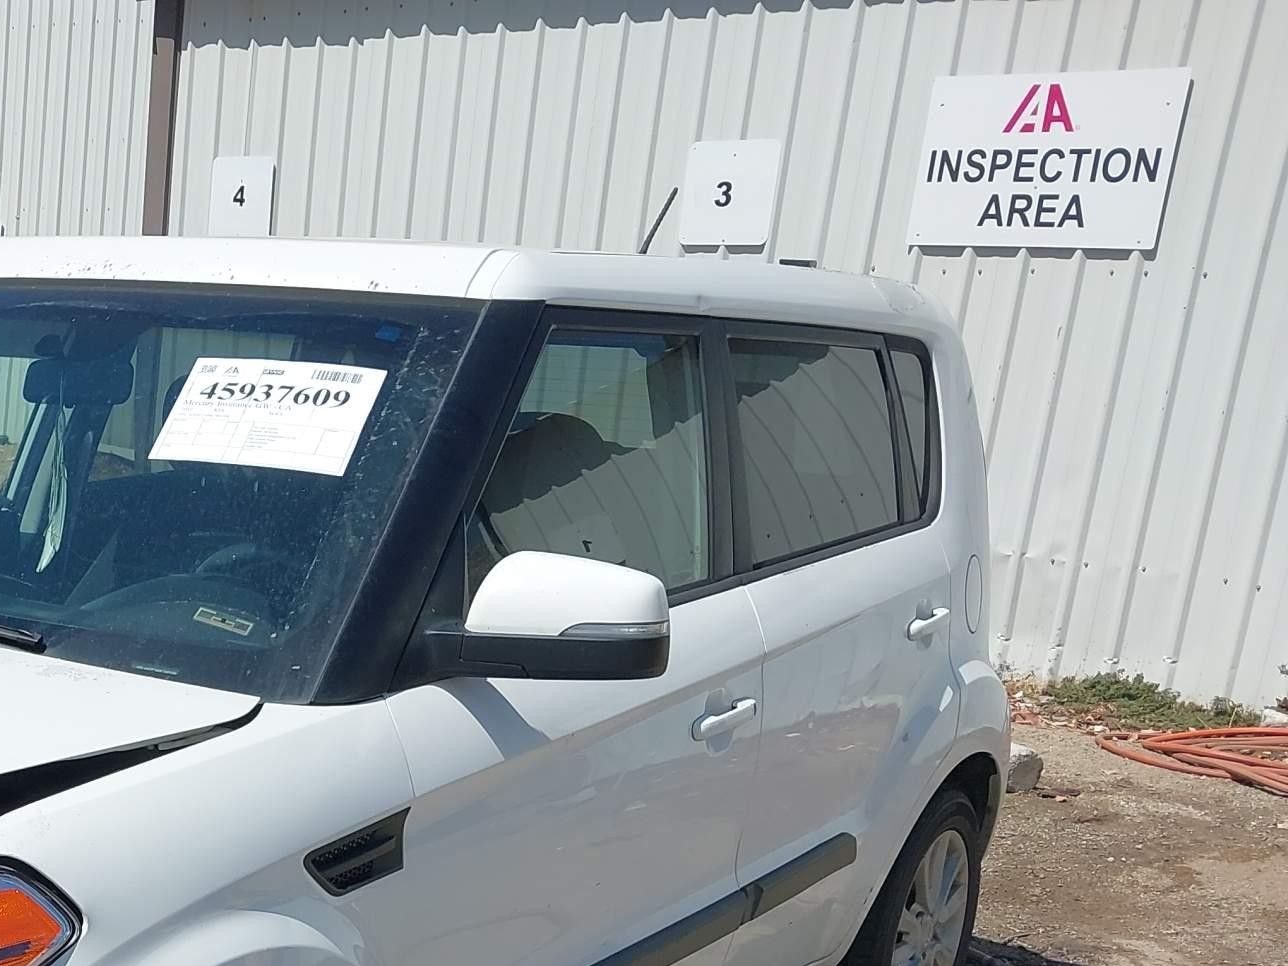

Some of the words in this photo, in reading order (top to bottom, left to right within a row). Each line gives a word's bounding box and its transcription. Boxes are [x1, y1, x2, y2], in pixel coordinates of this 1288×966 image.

[925, 147, 1163, 183] INSPECTION
[233, 185, 245, 207] 4
[714, 181, 732, 207] 3
[976, 194, 1085, 228] AREA
[199, 382, 351, 409] 45937609
